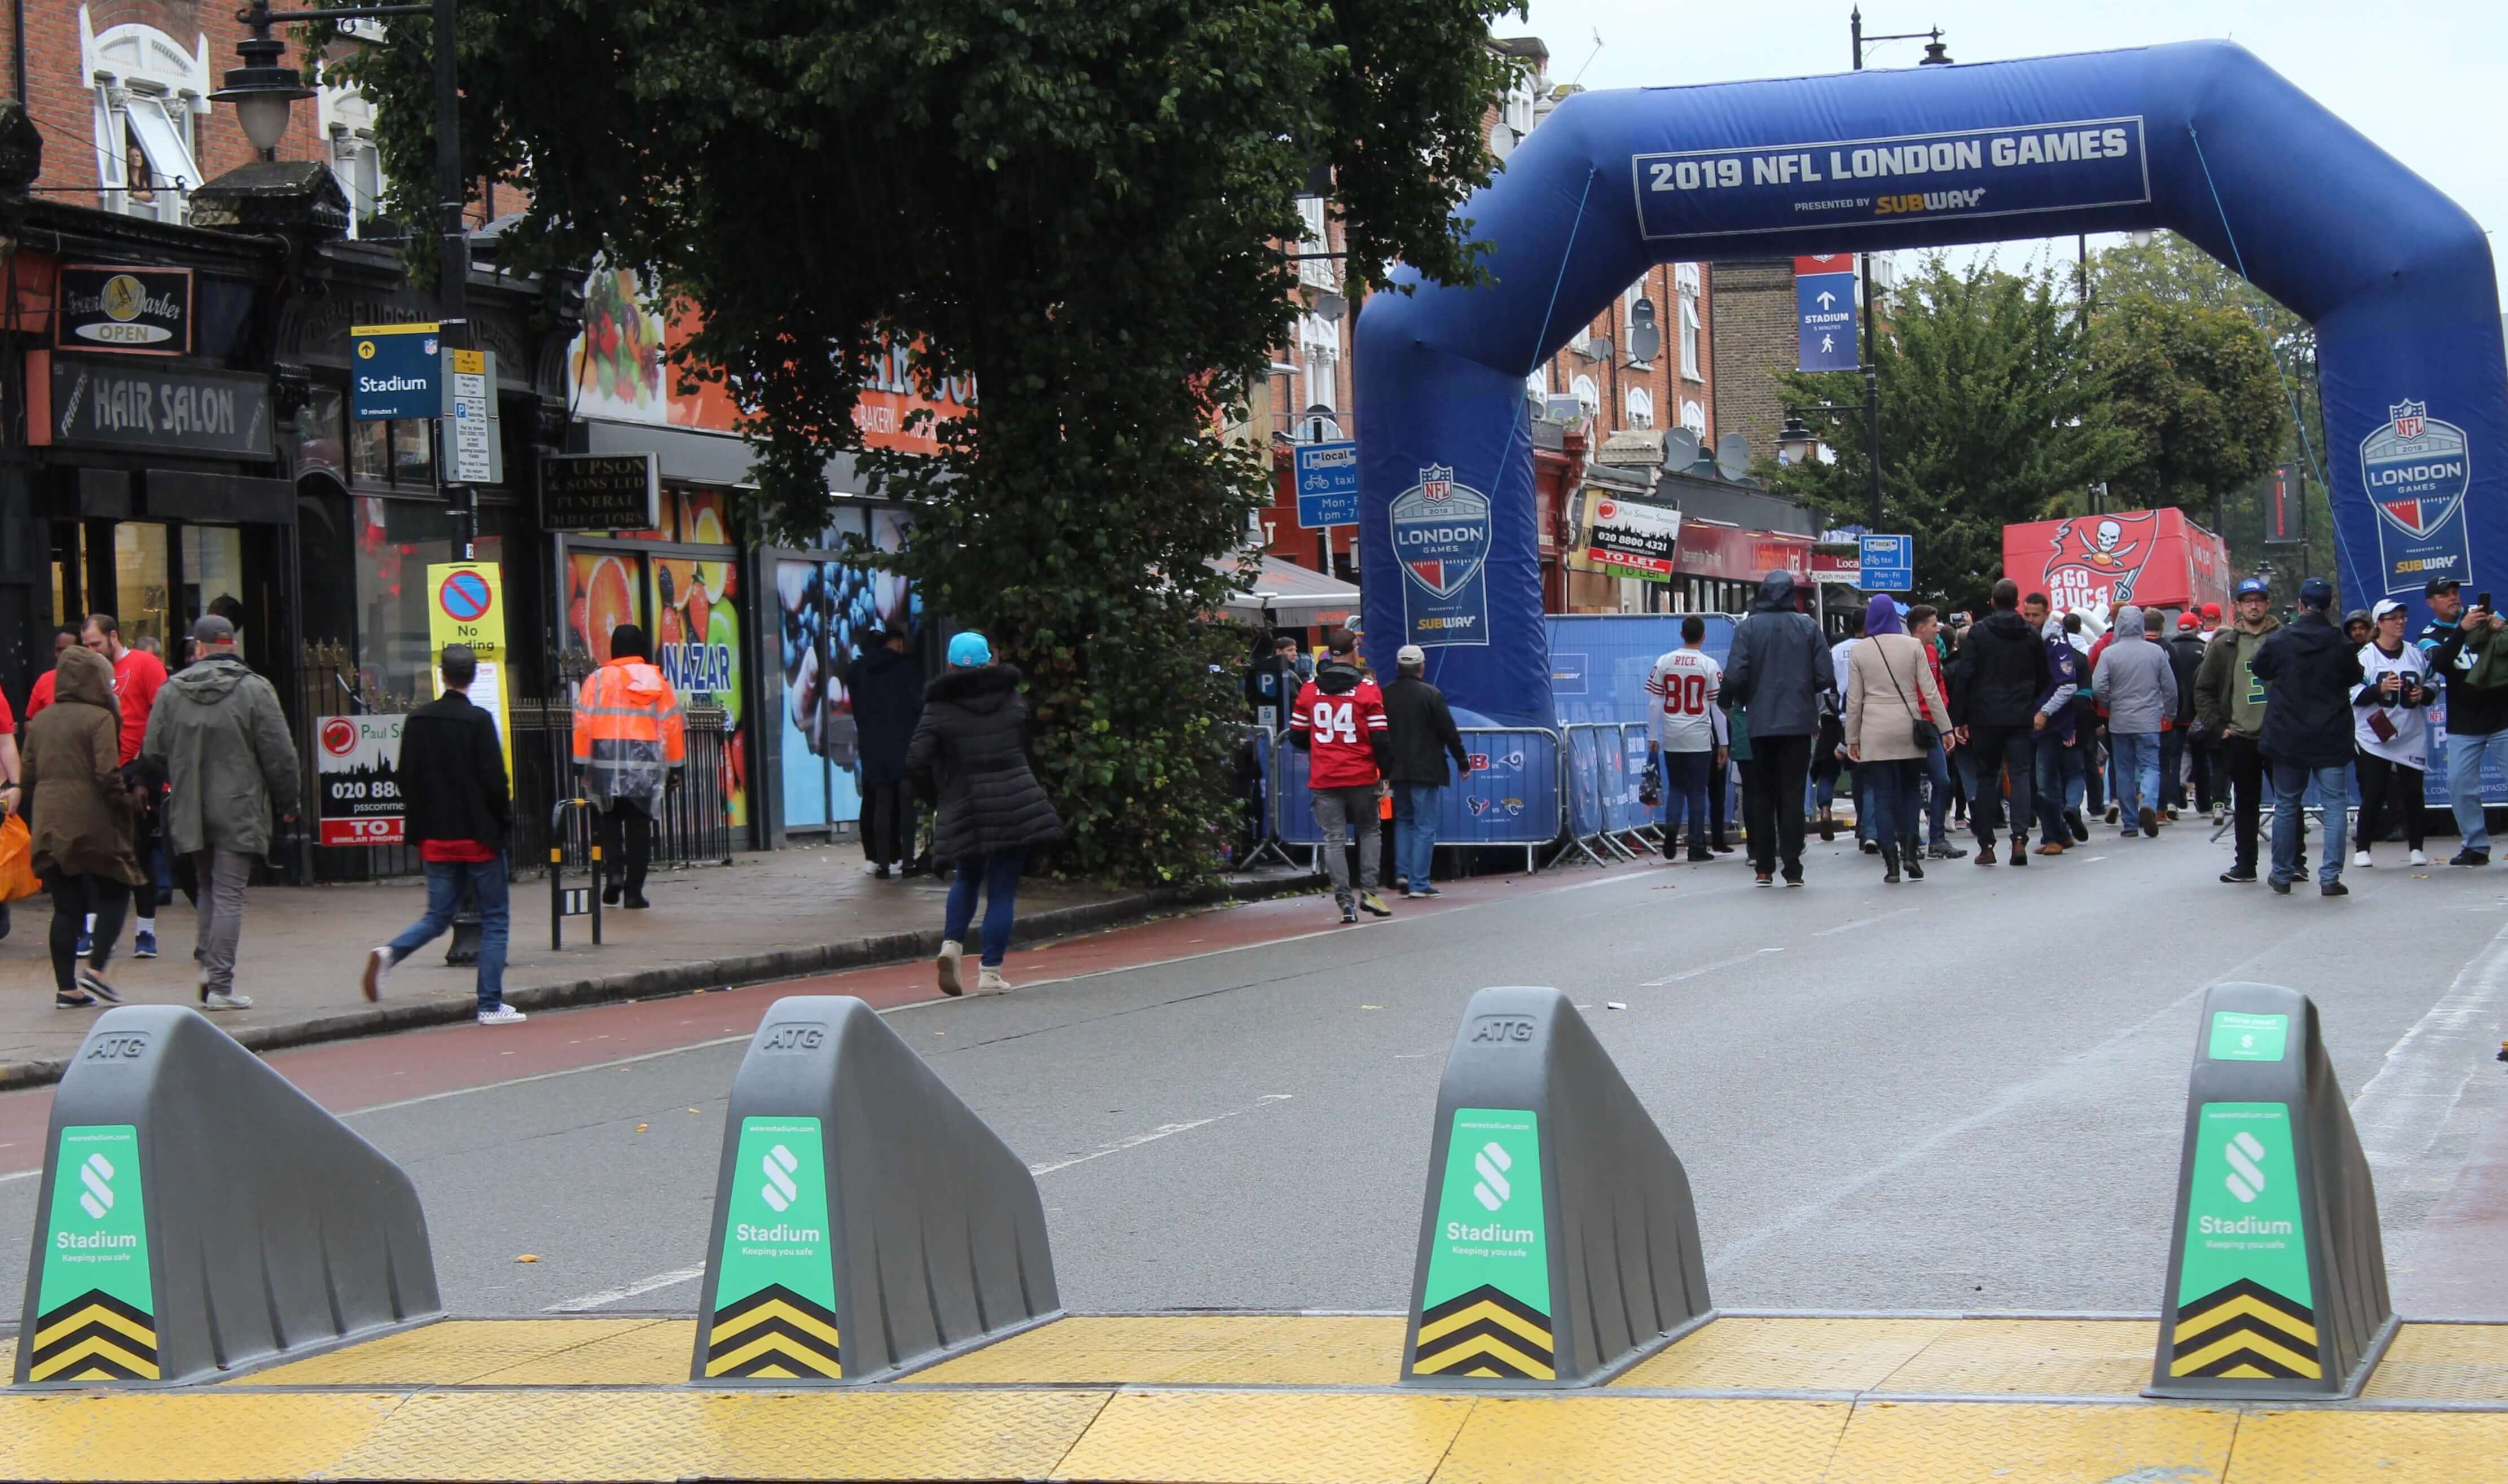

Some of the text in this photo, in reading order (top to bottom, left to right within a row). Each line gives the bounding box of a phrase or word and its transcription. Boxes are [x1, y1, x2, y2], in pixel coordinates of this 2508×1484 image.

[1650, 128, 2128, 192] 2019 NFL LONDON GAMES
[1795, 187, 1986, 215] PRESENTED BY SUBWAY
[130, 283, 181, 319] Barber
[1805, 313, 1849, 324] STADIUM
[99, 325, 148, 341] OPEN
[360, 375, 427, 392] Stadium
[61, 370, 88, 438] FRIENDS
[94, 377, 155, 434] HAIR
[160, 384, 235, 436] SALON
[458, 405, 464, 416] P
[860, 405, 894, 434] BAKERY
[2396, 418, 2423, 437] NFL
[1321, 451, 1347, 460] local
[573, 459, 645, 475] UPSON
[2371, 463, 2461, 486] LONDON
[548, 477, 645, 491] & SONS LTD
[1335, 475, 1354, 485] taxi
[2398, 483, 2436, 493] GAMES
[1425, 482, 1449, 499] NFL
[557, 495, 632, 508] FUNERAL
[1323, 499, 1345, 507] Mon
[550, 512, 644, 525] DIRECTORS
[1399, 527, 1483, 545] LONDON
[1598, 532, 1667, 551] 020 8800 4321
[1604, 551, 1624, 561] TO
[1629, 556, 1658, 567] LET
[2395, 555, 2457, 573] SUBWAY
[2050, 569, 2088, 589] #GO
[2051, 586, 2108, 609] BUCS
[458, 626, 478, 636] No
[1417, 616, 1476, 630] SUBWAY
[442, 640, 495, 652] lding
[664, 643, 731, 691] NAZAR
[1674, 656, 1697, 666] RICE
[1261, 673, 1273, 693] P
[1663, 674, 1706, 715] 80
[1313, 702, 1357, 744] 94
[2430, 712, 2444, 722] NFL
[362, 724, 387, 739] Paul
[332, 782, 366, 798] 020
[354, 802, 405, 814] psscomme
[350, 820, 389, 835] TO
[764, 1028, 824, 1050] ATG
[1472, 1020, 1534, 1042] ATG
[87, 1038, 146, 1059] ATG
[737, 1224, 819, 1242] Stadium
[1447, 1222, 1534, 1242] Stadium
[2199, 1215, 2292, 1235] Stadium
[57, 1231, 136, 1249] Stadium
[2206, 1240, 2285, 1250] Keeping you safe
[62, 1254, 95, 1263] Keeping
[742, 1246, 777, 1256] Keeping
[794, 1247, 812, 1255] safe
[1452, 1246, 1527, 1257] Keeping you safe
